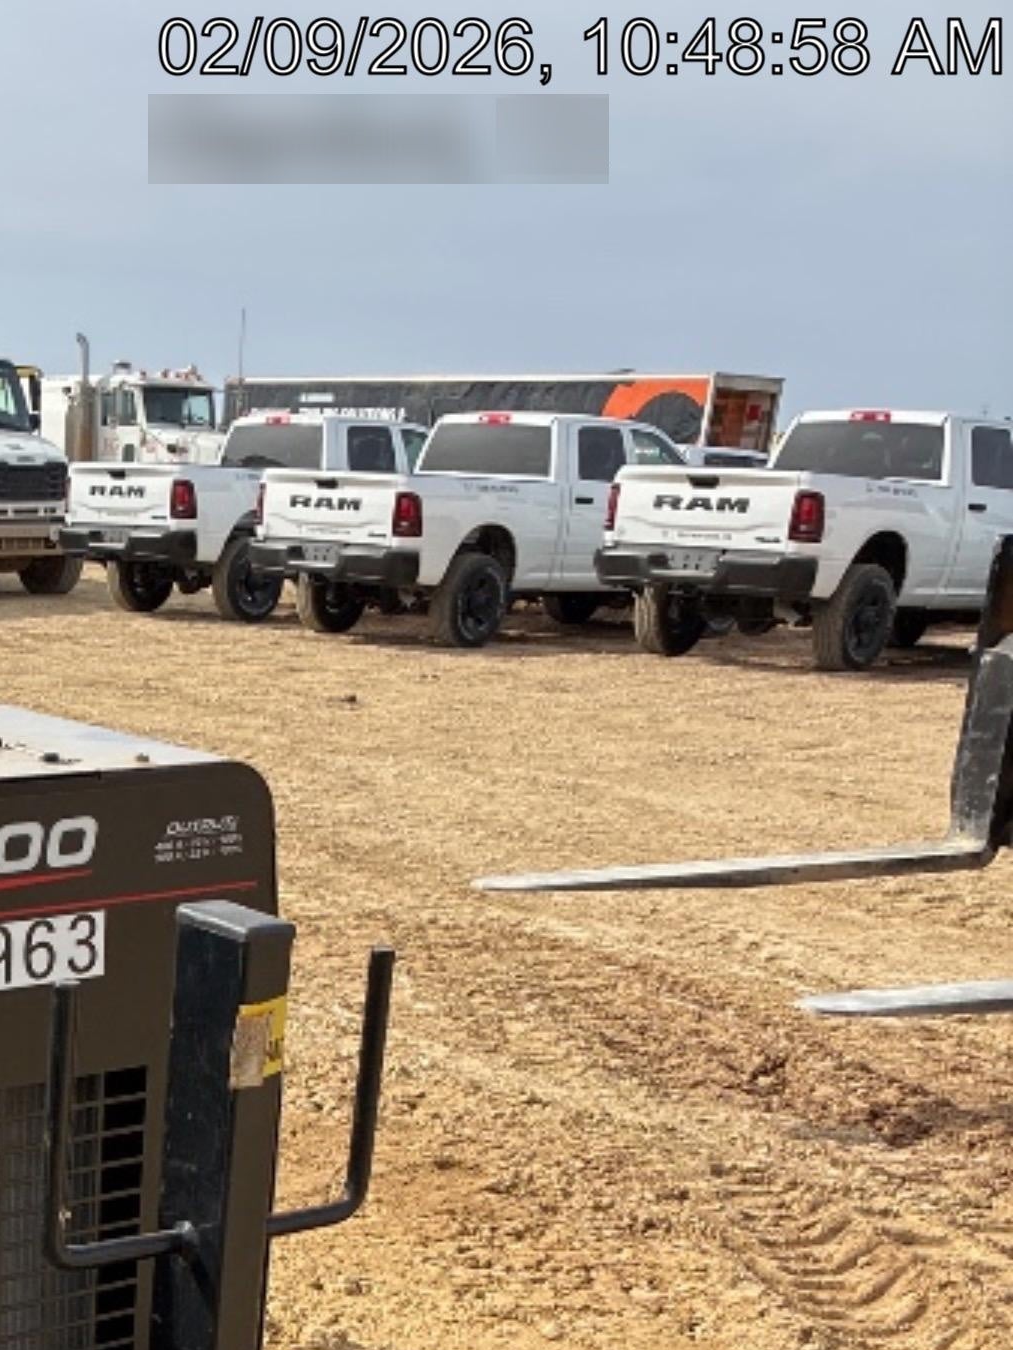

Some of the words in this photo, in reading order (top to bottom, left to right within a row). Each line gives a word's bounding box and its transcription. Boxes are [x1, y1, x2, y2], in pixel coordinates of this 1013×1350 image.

[89, 484, 146, 499] RAM
[289, 494, 363, 512] RAM
[652, 493, 751, 514] RAM
